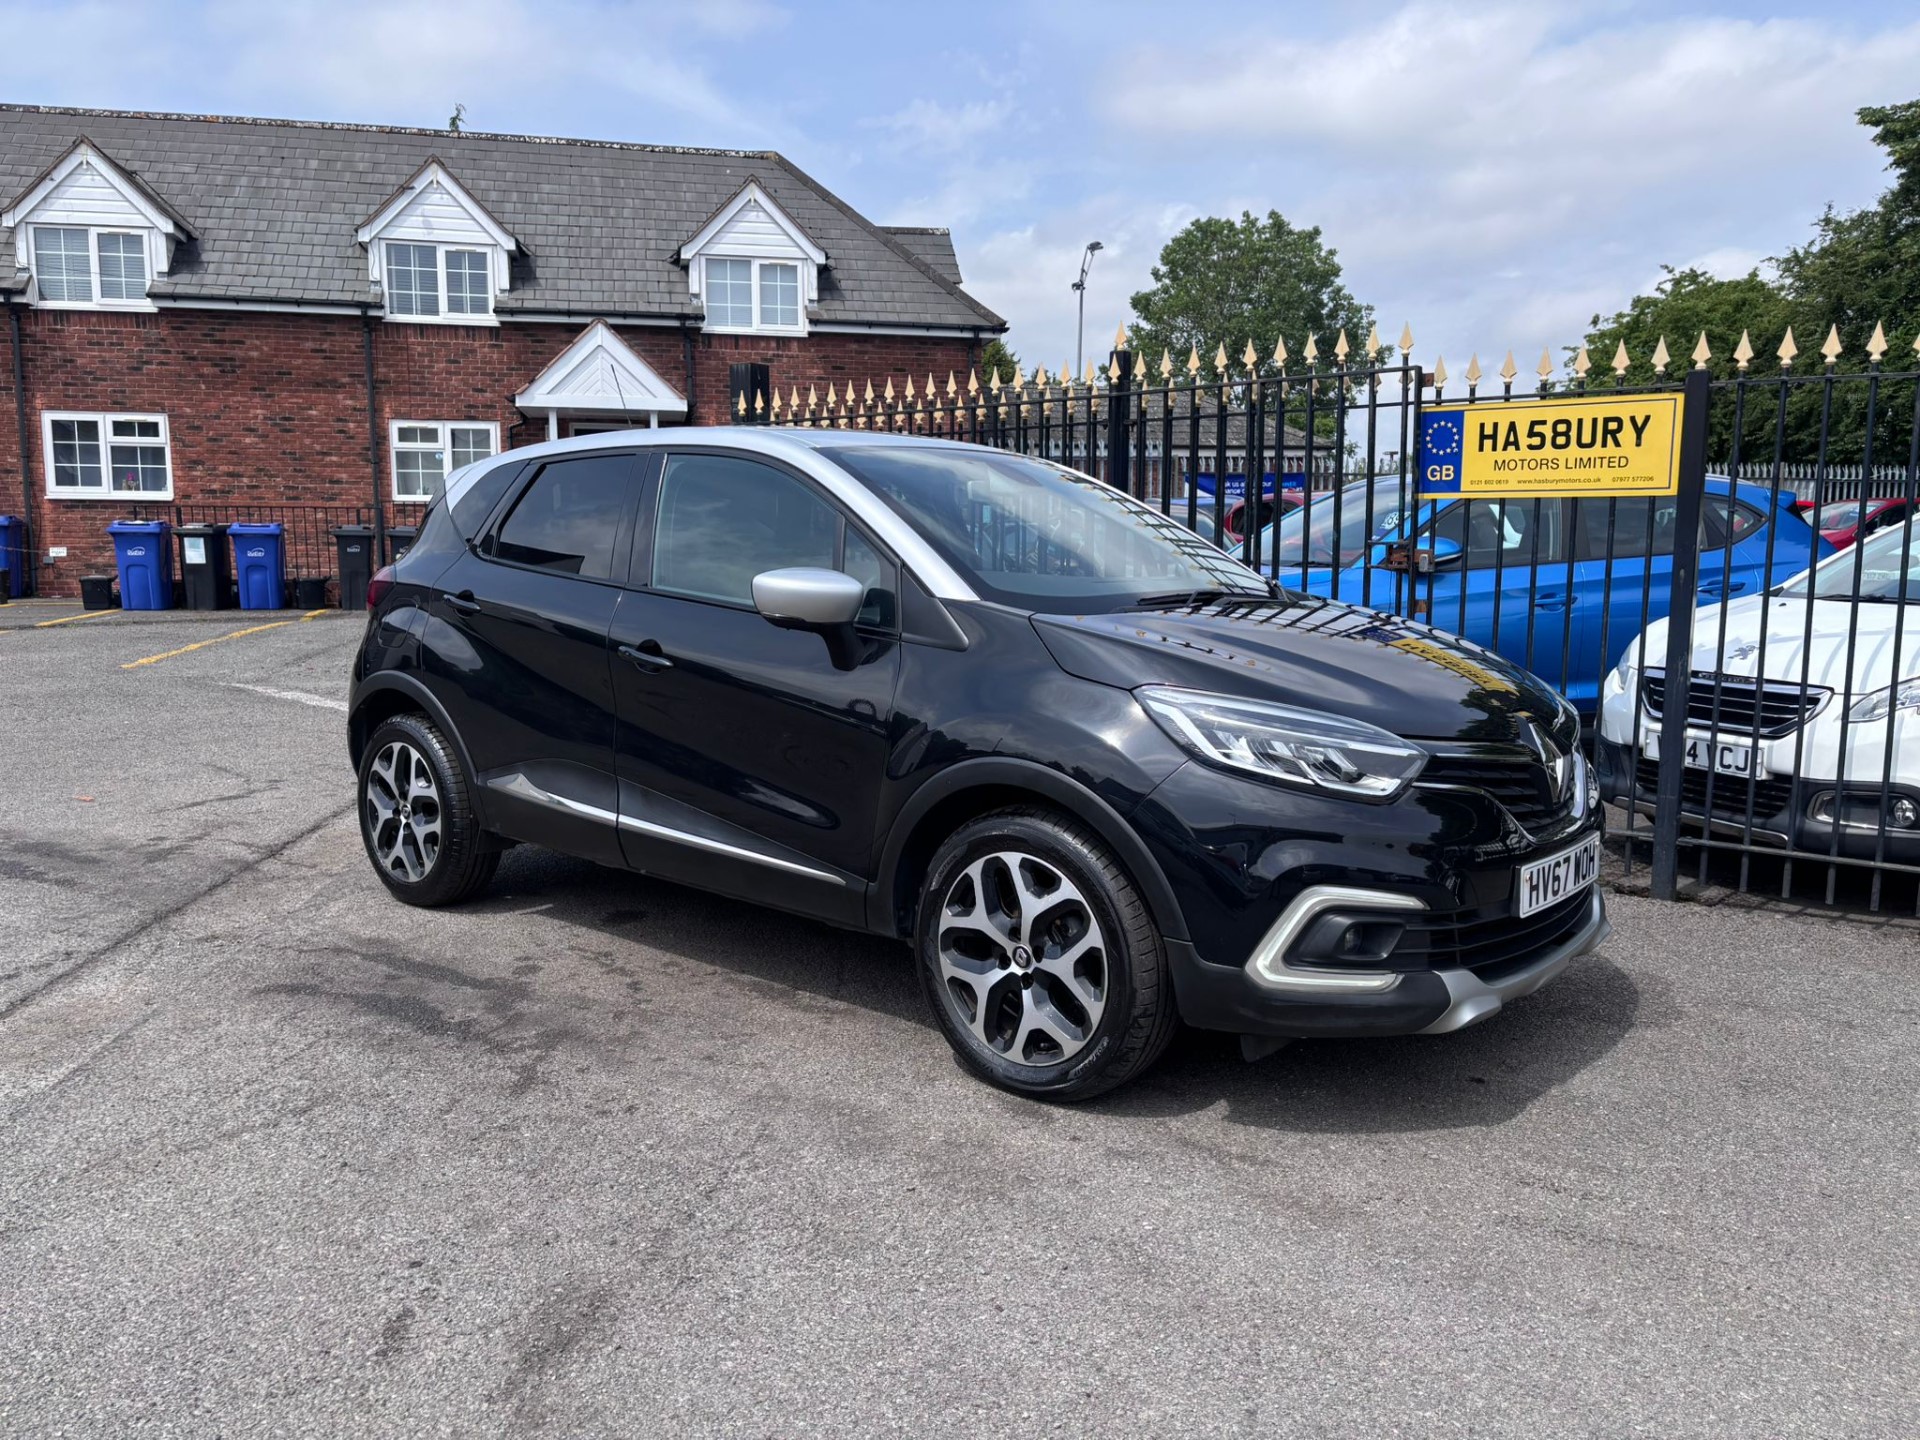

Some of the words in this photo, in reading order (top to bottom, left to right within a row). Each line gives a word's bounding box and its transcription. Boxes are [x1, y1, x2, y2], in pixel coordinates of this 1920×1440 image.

[1493, 458, 1560, 472] MOTORS
[1565, 455, 1629, 470] LIMITED
[1426, 465, 1455, 481] GB
[1517, 477, 1601, 485] www.hasburymotors.co.uk
[1528, 855, 1571, 909] HV67
